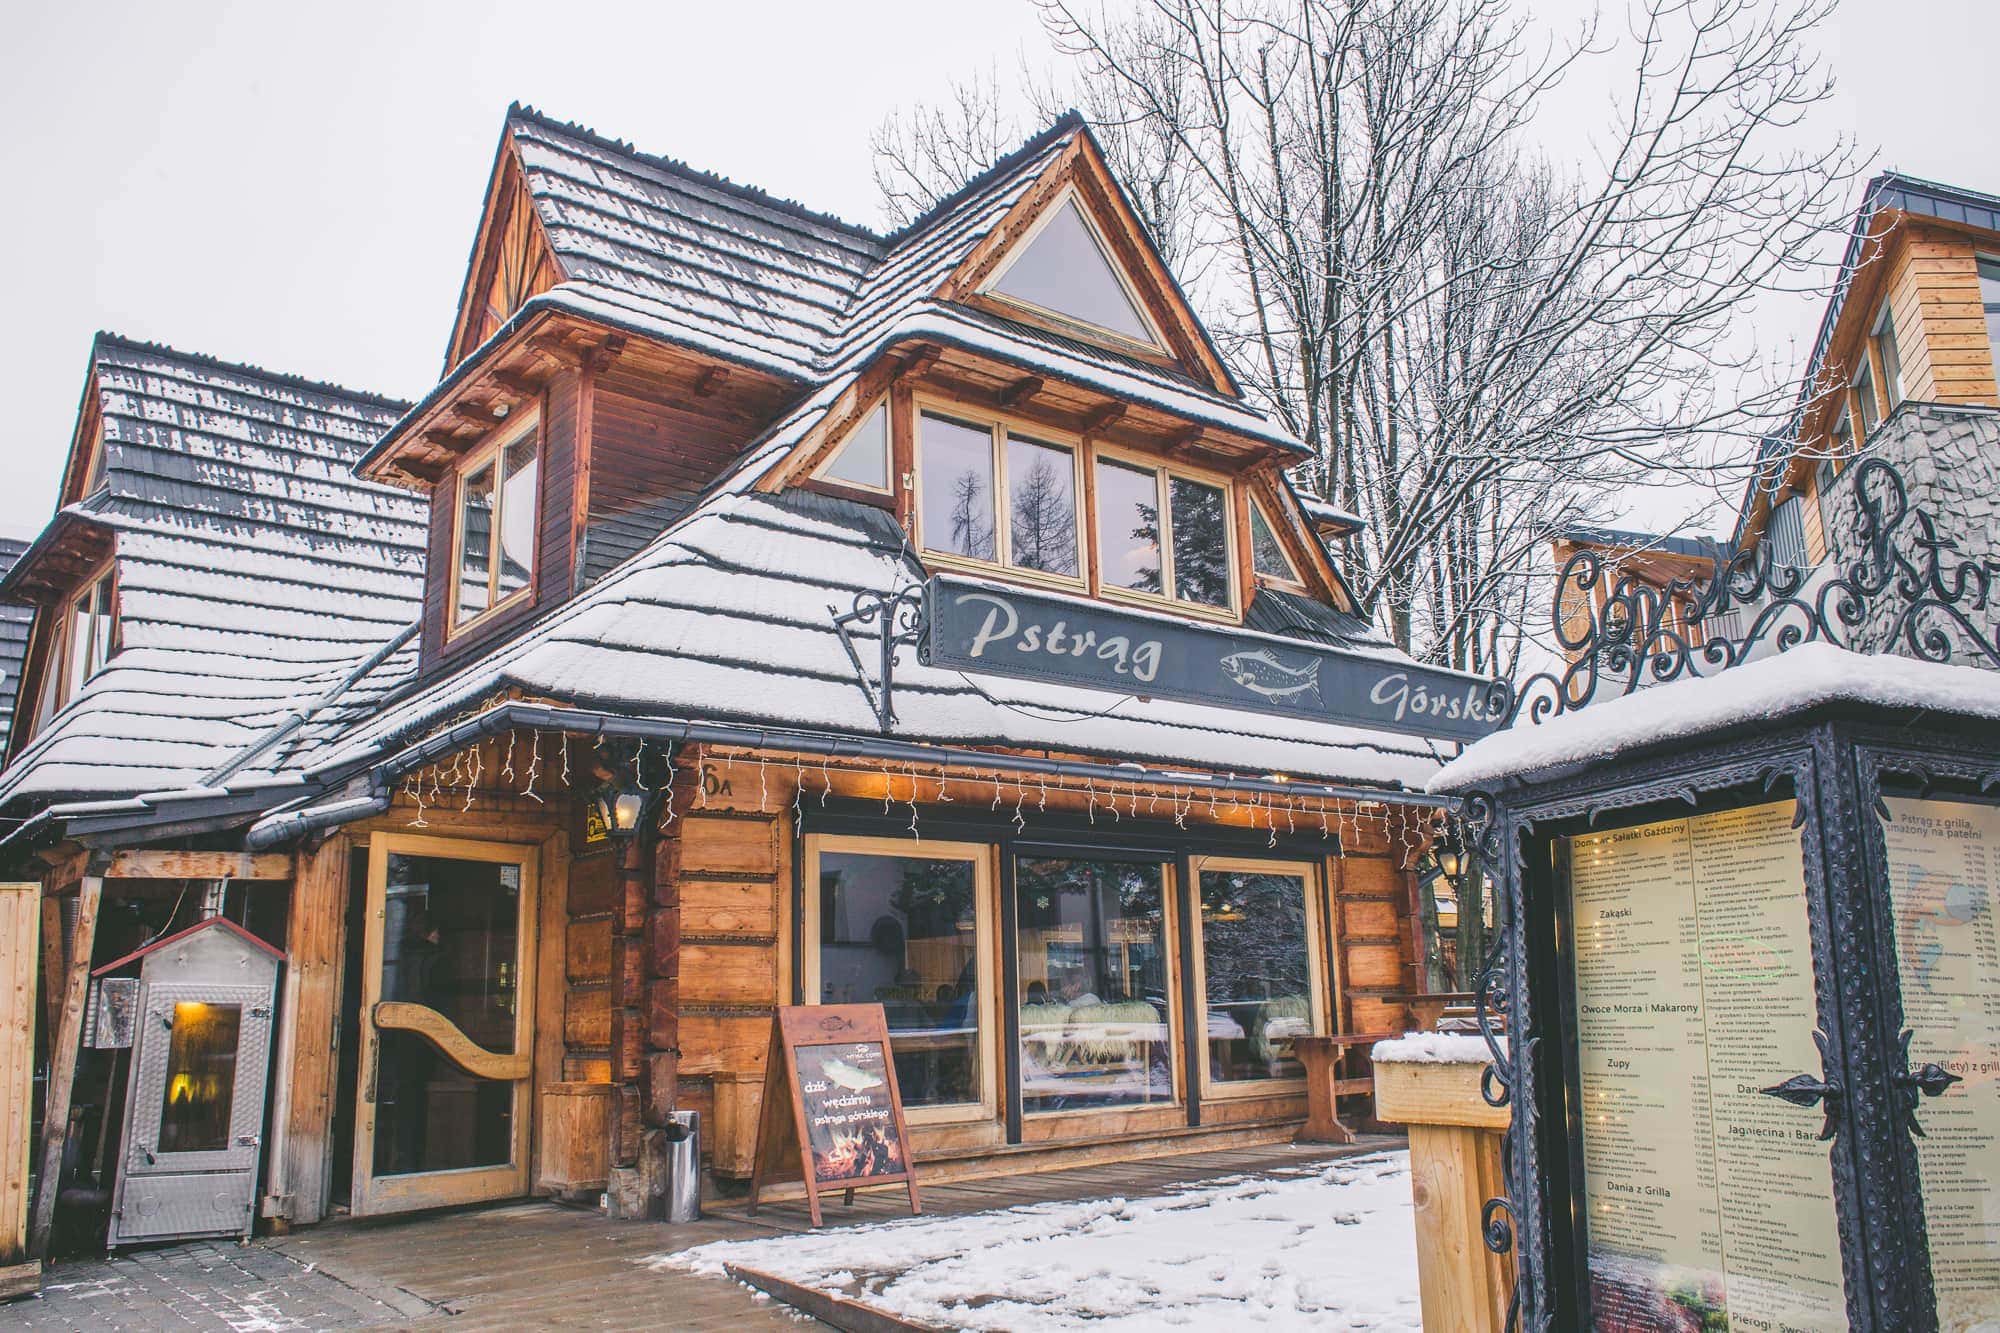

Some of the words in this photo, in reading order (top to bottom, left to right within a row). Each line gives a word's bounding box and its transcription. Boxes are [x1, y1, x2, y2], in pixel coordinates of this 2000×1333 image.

[956, 593, 1163, 681] Pstrąg
[1901, 813, 1933, 827] Pstrąg
[1935, 819, 1941, 827] z
[1885, 822, 1928, 838] smażony
[1932, 828, 1943, 837] na
[1947, 829, 1982, 839] patelni
[1599, 907, 1632, 920] Zakąski
[1581, 1004, 1611, 1014] Owoce
[1614, 1003, 1642, 1013] Morza
[1651, 1003, 1699, 1014] Makarony
[1607, 1058, 1630, 1069] Zupy
[1972, 1063, 1977, 1071] z
[1981, 1061, 2000, 1073] grill
[1607, 1181, 1634, 1193] Dania
[1636, 1186, 1642, 1194] z
[1645, 1185, 1671, 1197] Grilla
[1732, 1311, 1772, 1331] Pierogi
